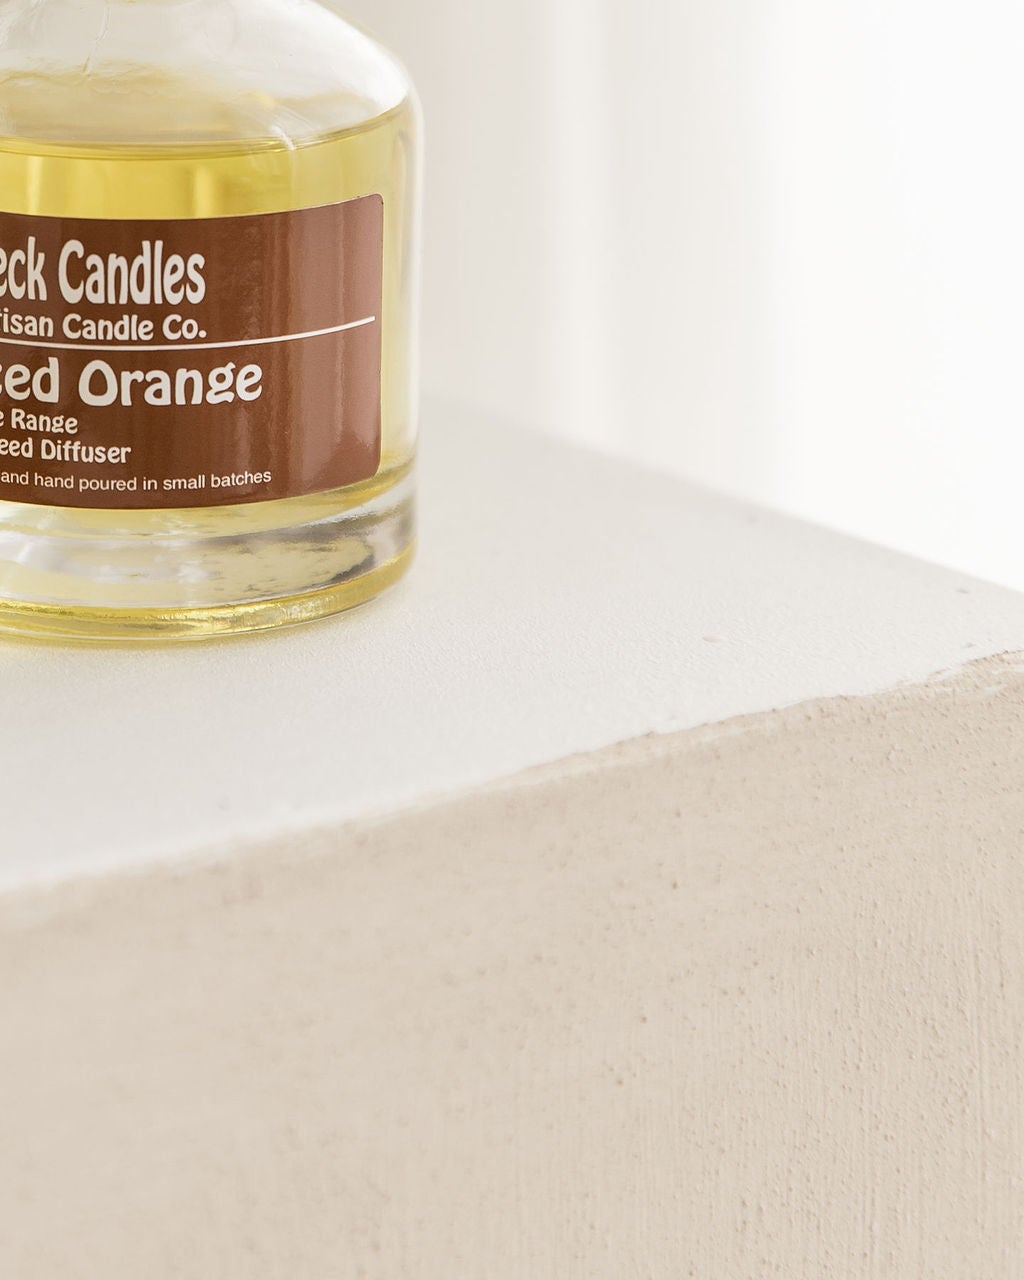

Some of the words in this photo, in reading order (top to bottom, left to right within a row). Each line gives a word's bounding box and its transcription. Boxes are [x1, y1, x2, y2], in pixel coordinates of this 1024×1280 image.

[58, 240, 206, 305] Candles
[62, 313, 153, 341] Candle
[163, 314, 207, 340] Co.
[79, 360, 263, 406] Orange
[11, 408, 78, 434] Range
[41, 439, 131, 463] Diffuser
[35, 472, 74, 489] hand
[79, 476, 137, 492] poured
[143, 476, 157, 490] in
[163, 474, 205, 490] small
[211, 470, 272, 488] batches
